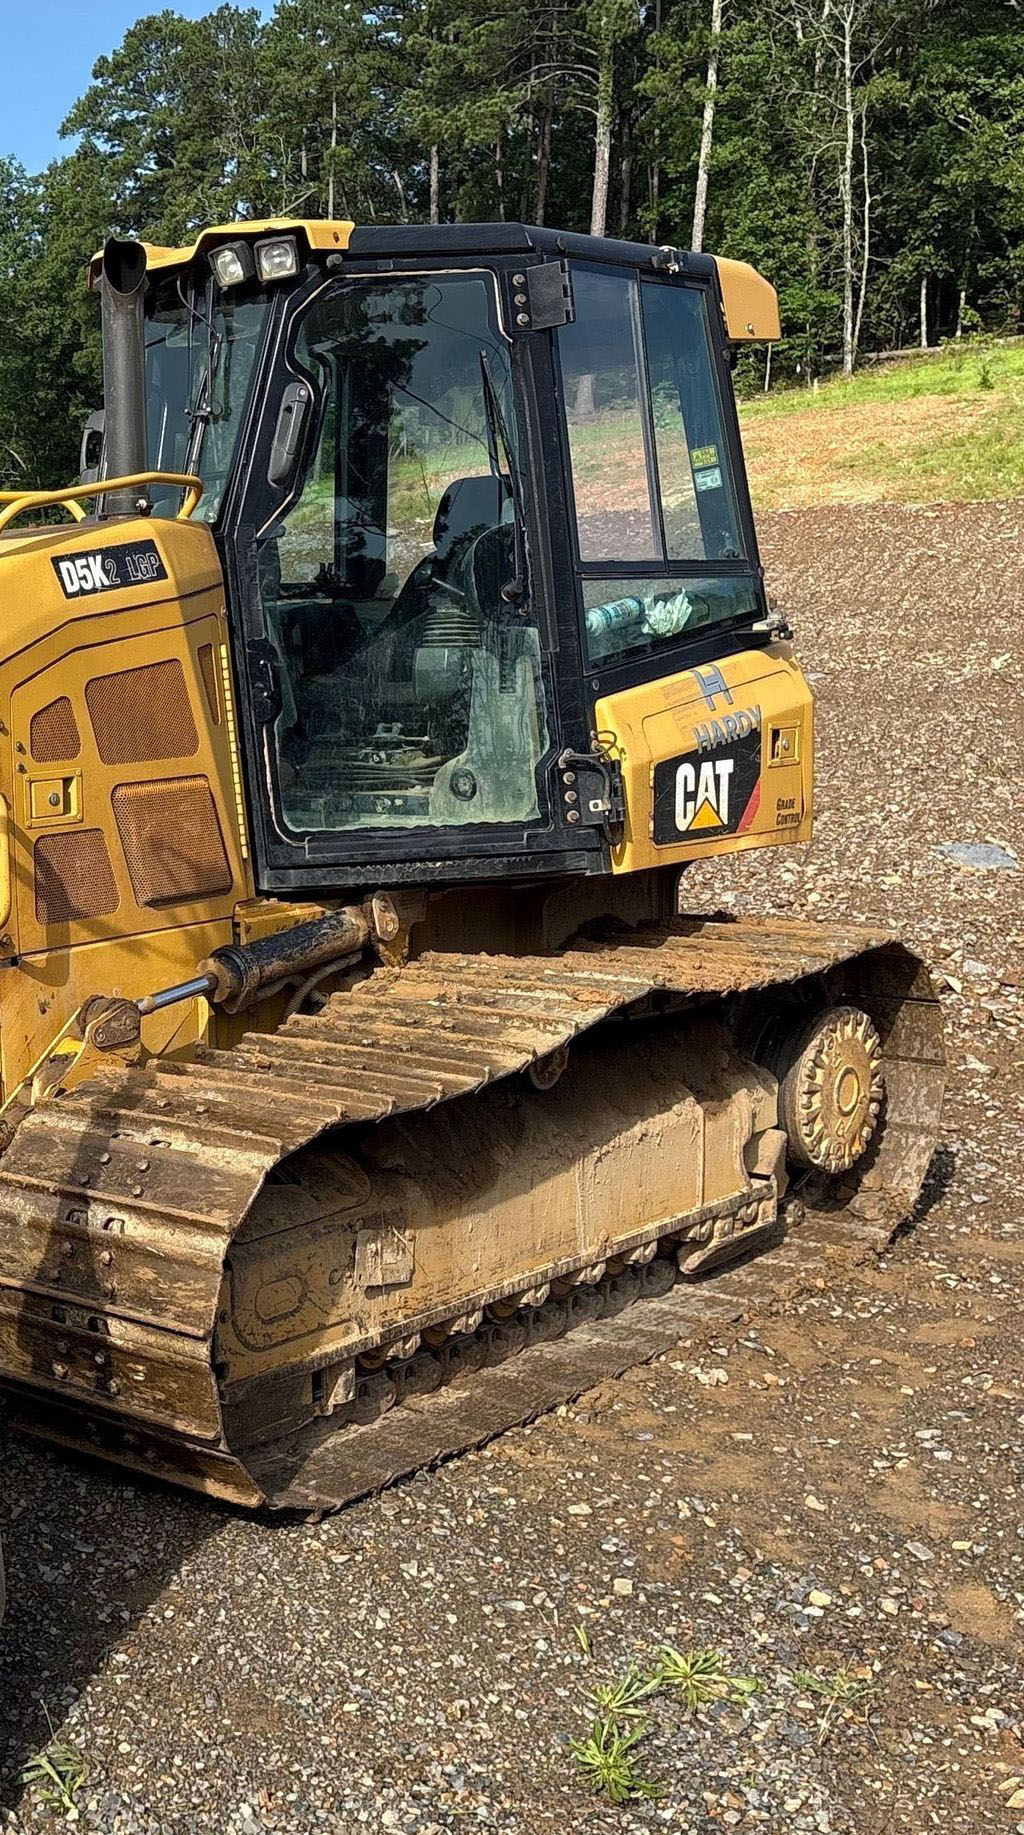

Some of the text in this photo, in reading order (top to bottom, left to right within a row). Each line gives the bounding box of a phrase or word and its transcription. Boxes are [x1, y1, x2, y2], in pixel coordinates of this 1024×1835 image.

[59, 552, 160, 593] D5K2 LGP
[692, 704, 761, 754] HARDY
[675, 758, 733, 831] CAT
